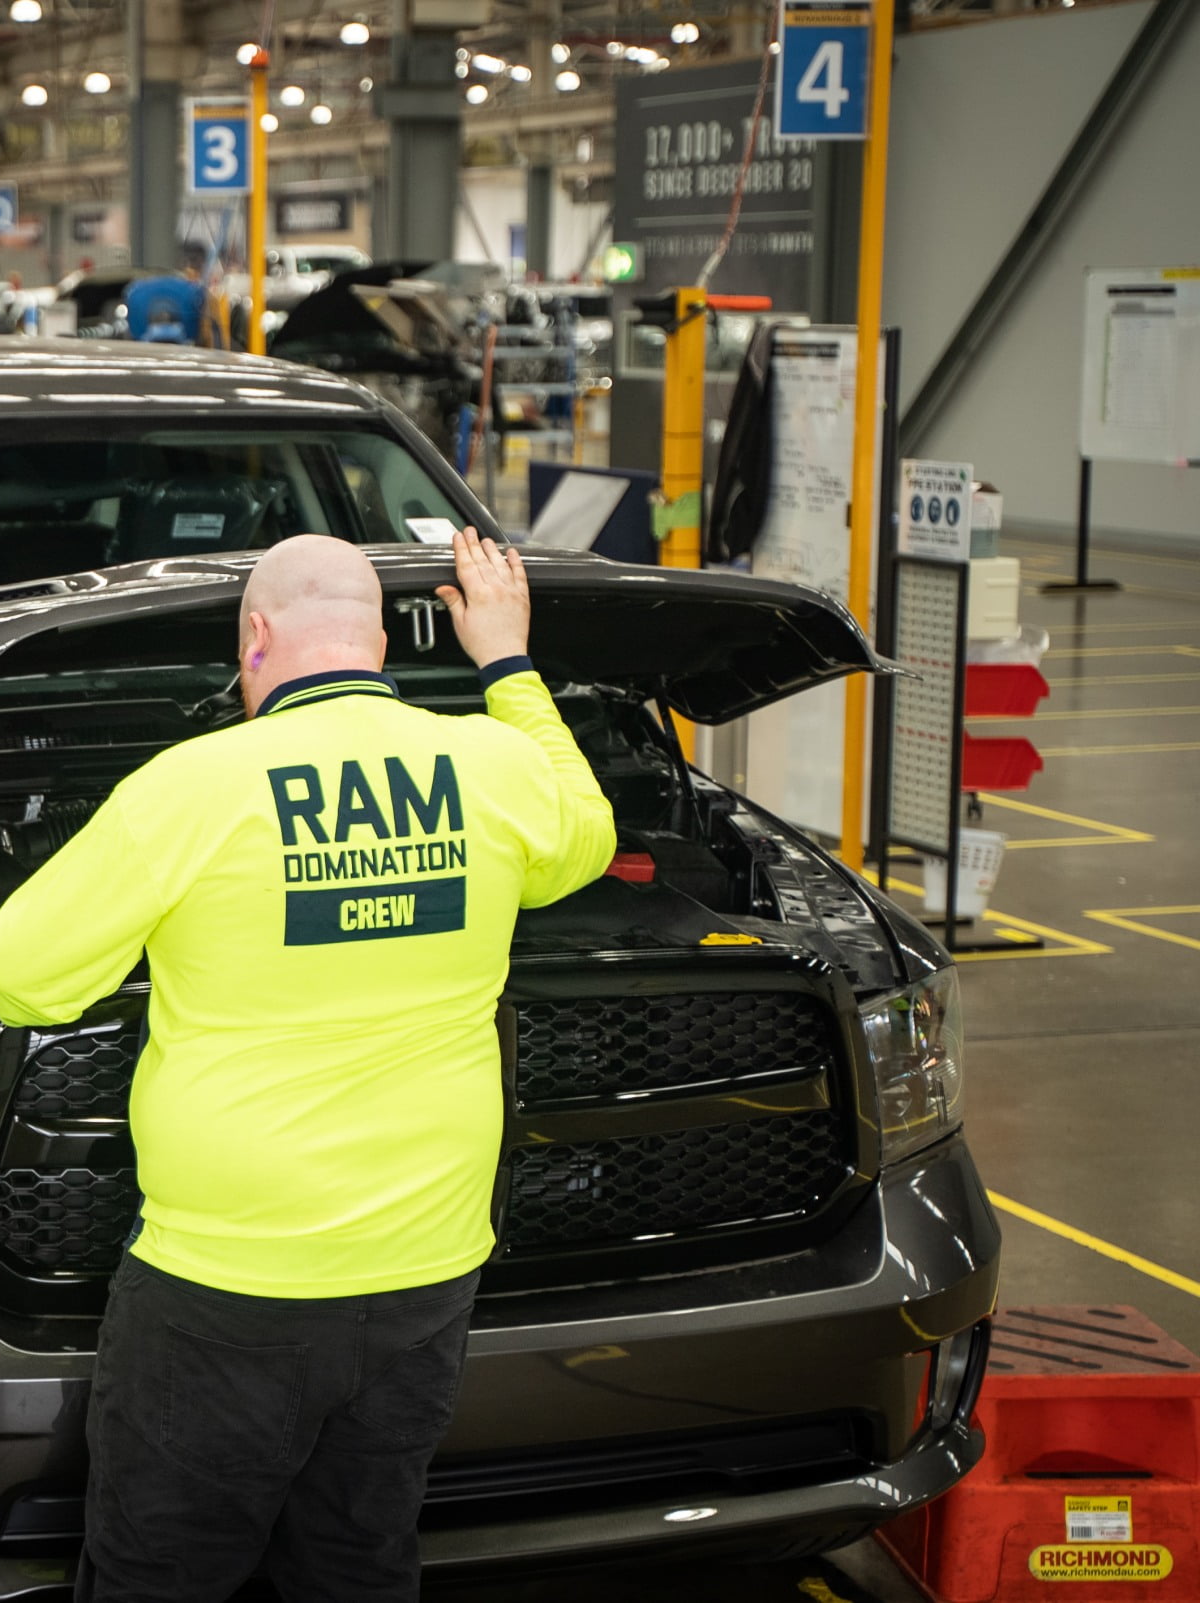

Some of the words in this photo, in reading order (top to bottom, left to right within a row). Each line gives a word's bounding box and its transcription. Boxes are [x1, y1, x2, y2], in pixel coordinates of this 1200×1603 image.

[796, 40, 850, 118] 4
[202, 126, 238, 182] 3
[644, 167, 692, 199] SINCE
[267, 755, 464, 846] RAM
[284, 839, 466, 882] DOMINATION
[340, 894, 415, 931] CREW
[1040, 1551, 1160, 1566] RICHMOND
[1041, 1567, 1160, 1577] www.richmondau.com
